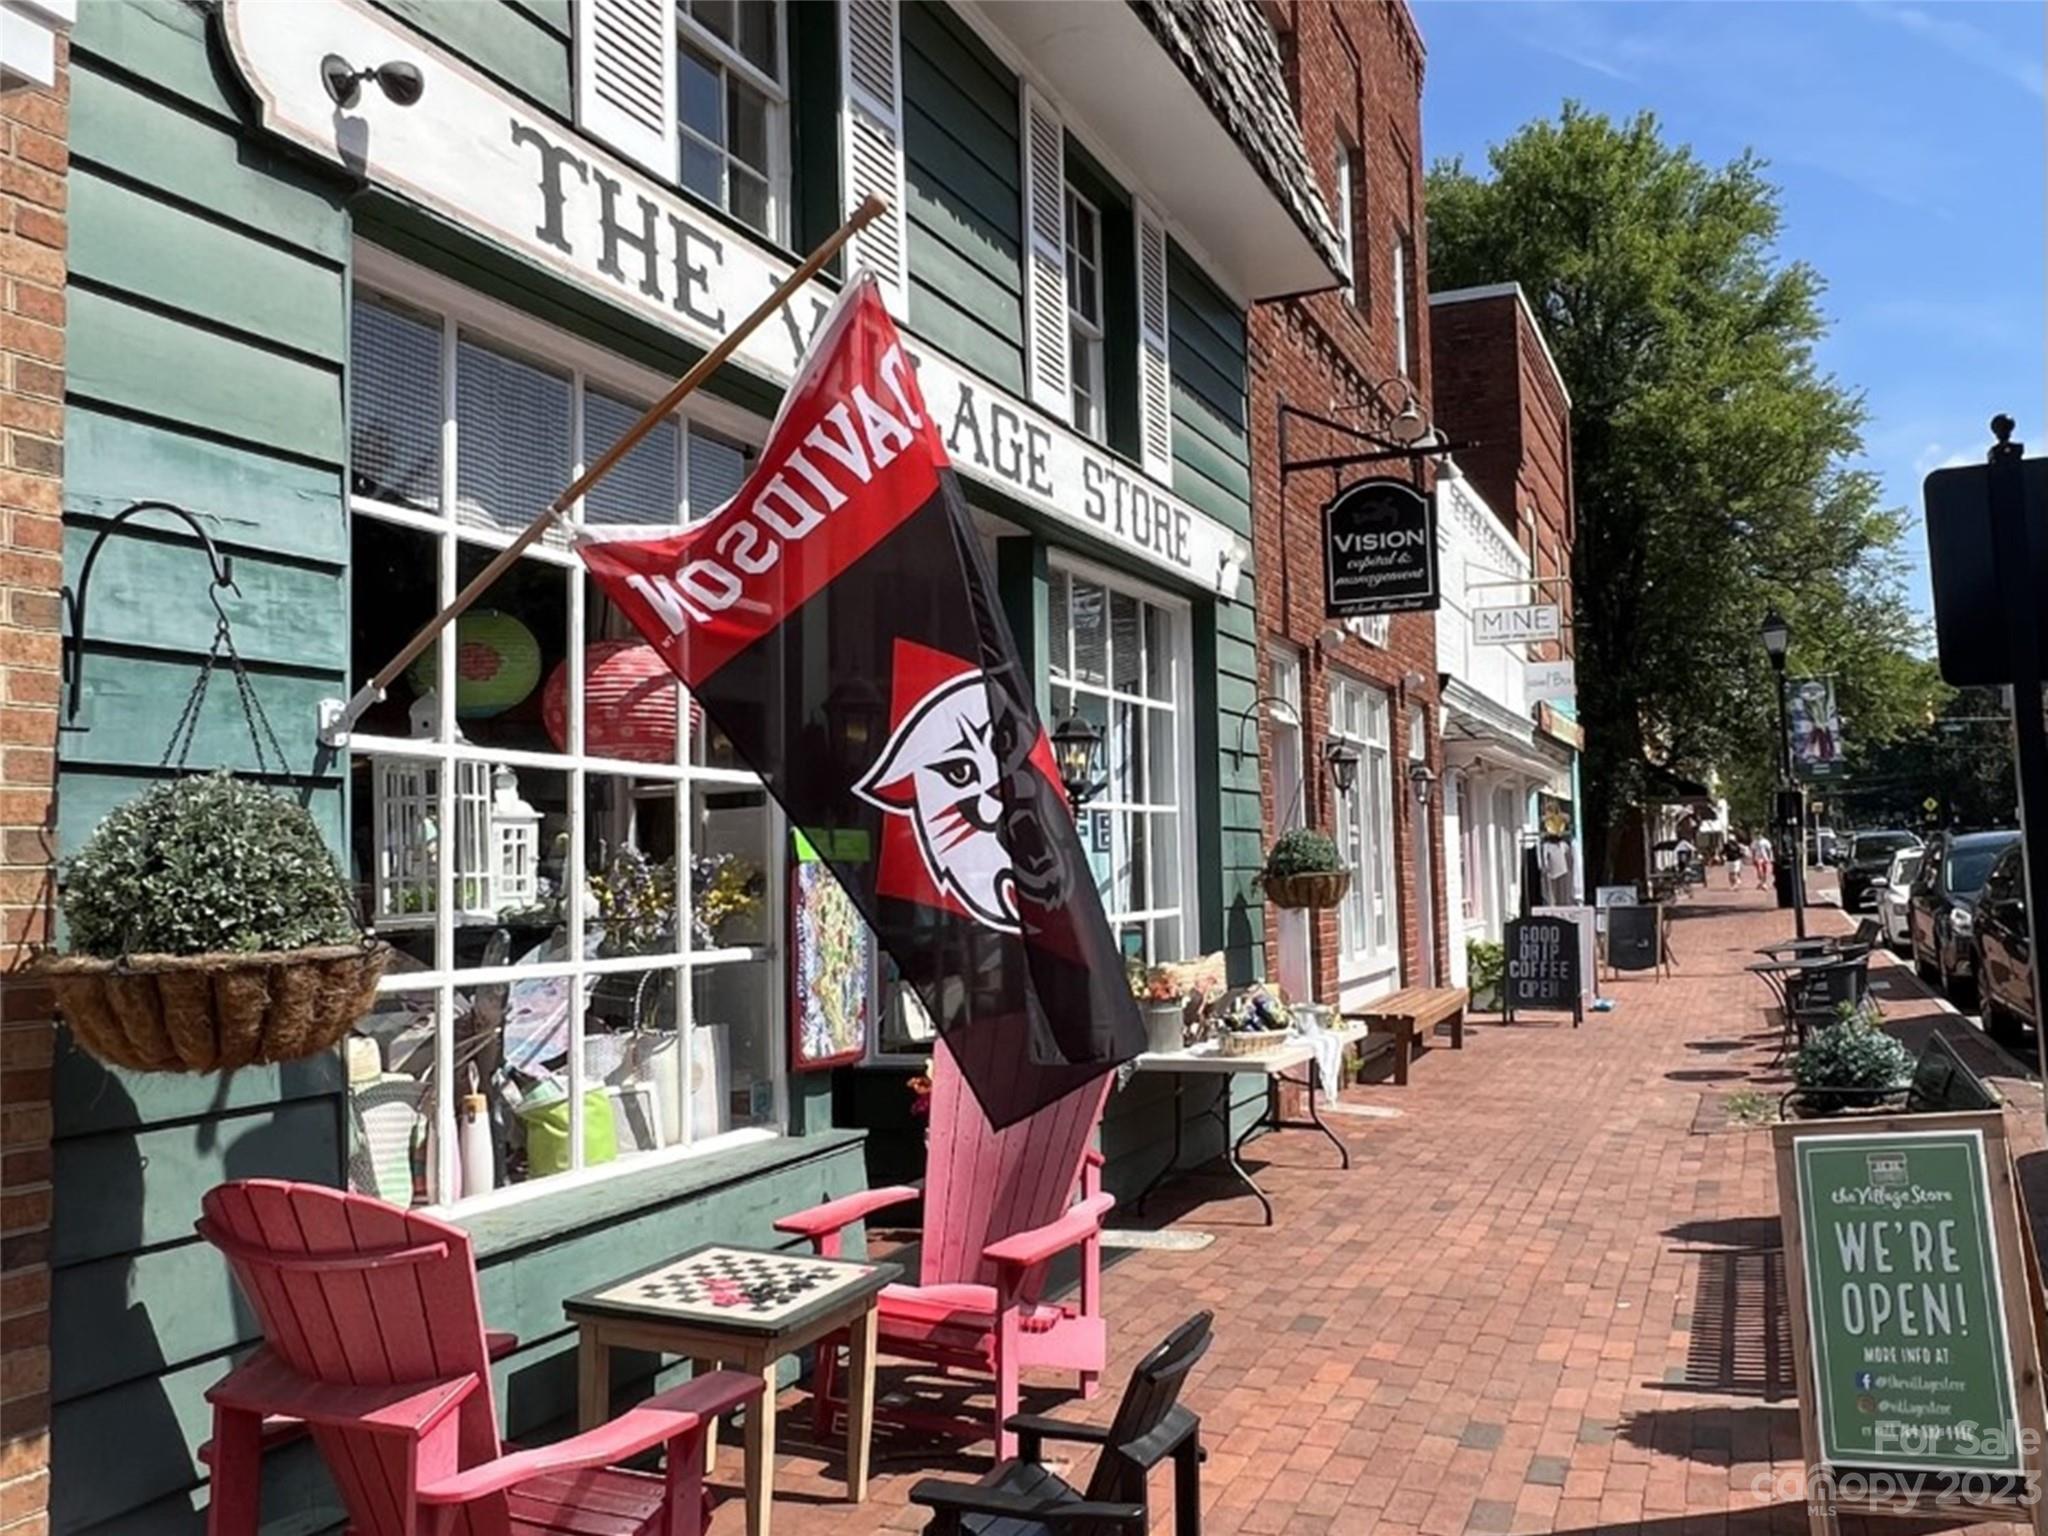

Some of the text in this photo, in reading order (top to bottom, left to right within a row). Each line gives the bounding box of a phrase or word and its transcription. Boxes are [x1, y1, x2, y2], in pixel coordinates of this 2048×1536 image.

[510, 118, 1193, 568] THE VAGE STORE
[1333, 529, 1425, 552] VISION
[1335, 567, 1425, 588] management
[1482, 608, 1552, 632] MINE
[1519, 926, 1560, 943] GOOD
[1519, 944, 1560, 961] DRIP
[1509, 961, 1570, 979] COFFEE
[1518, 980, 1560, 999] OPEN
[1831, 1186, 1857, 1205] the
[1911, 1184, 1954, 1204] Store
[1834, 1219, 1961, 1273] WE'RE
[1841, 1282, 1969, 1336] OPEN!
[1863, 1346, 1949, 1365] MORE INFO AT
